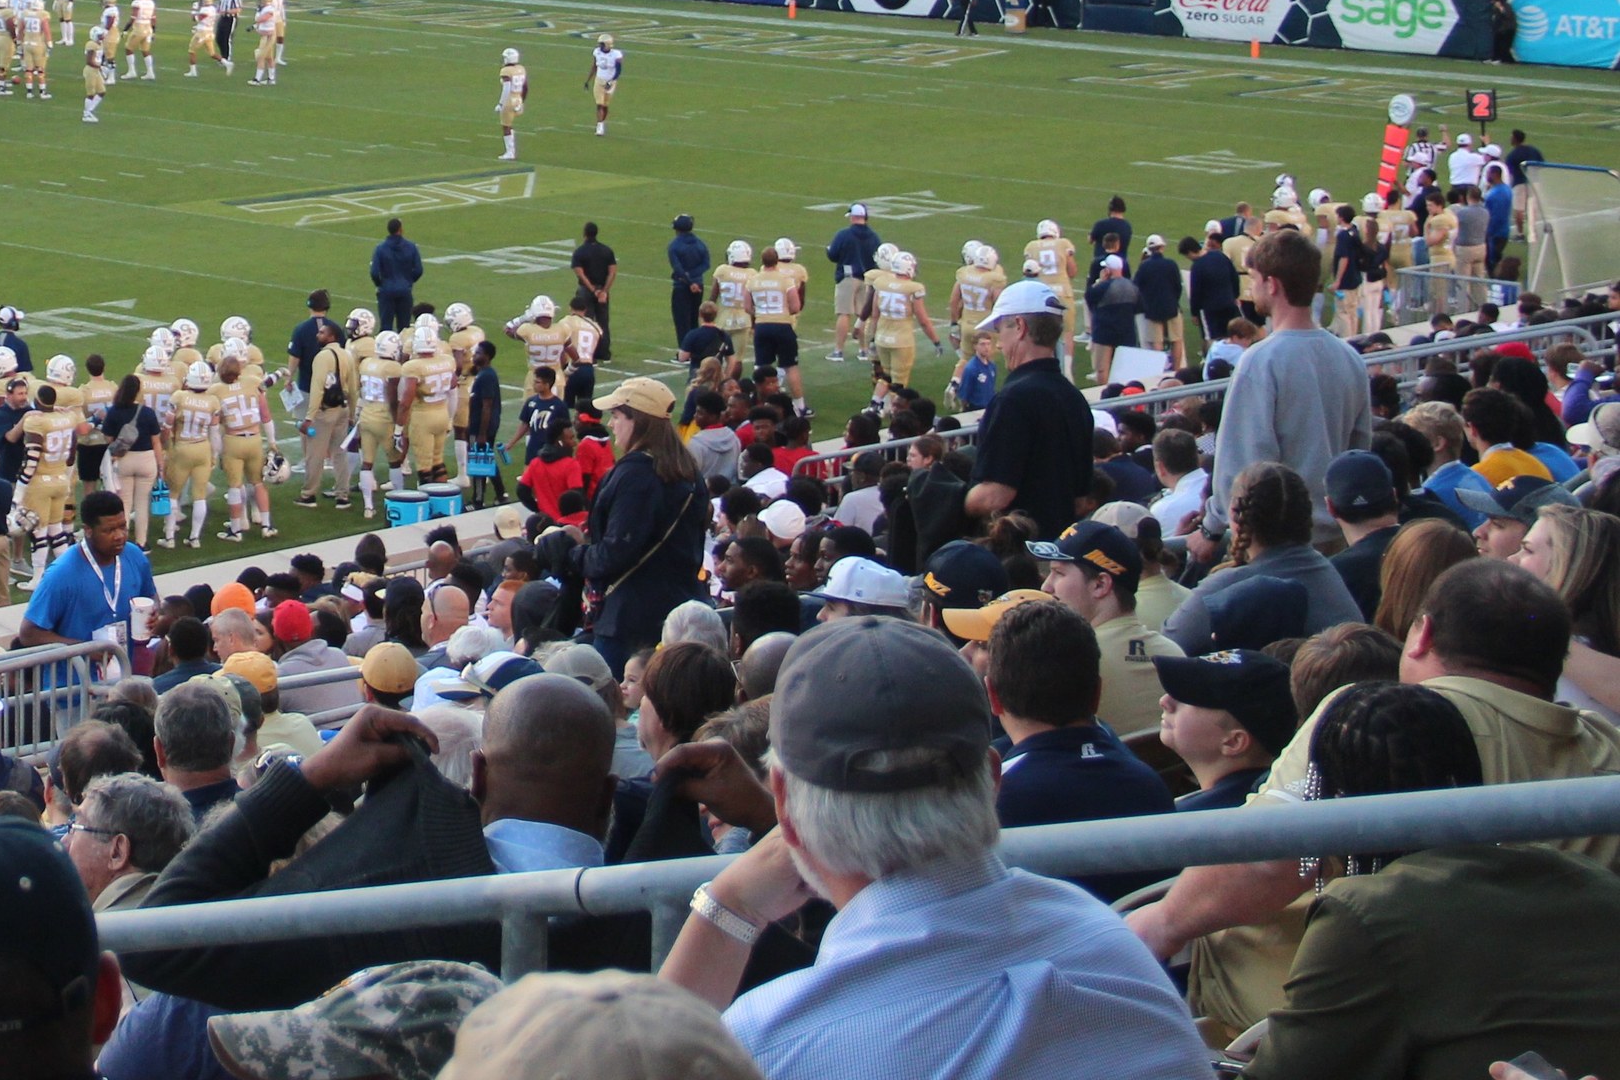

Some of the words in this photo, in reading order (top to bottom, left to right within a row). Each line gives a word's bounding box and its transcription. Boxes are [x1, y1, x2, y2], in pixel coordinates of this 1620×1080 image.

[1186, 11, 1219, 23] zero
[1222, 14, 1265, 26] SUGAR
[1555, 14, 1619, 39] AT&T
[1472, 93, 1490, 117] 2
[960, 284, 989, 311] 57
[223, 394, 261, 428] 54
[1129, 640, 1147, 656] R
